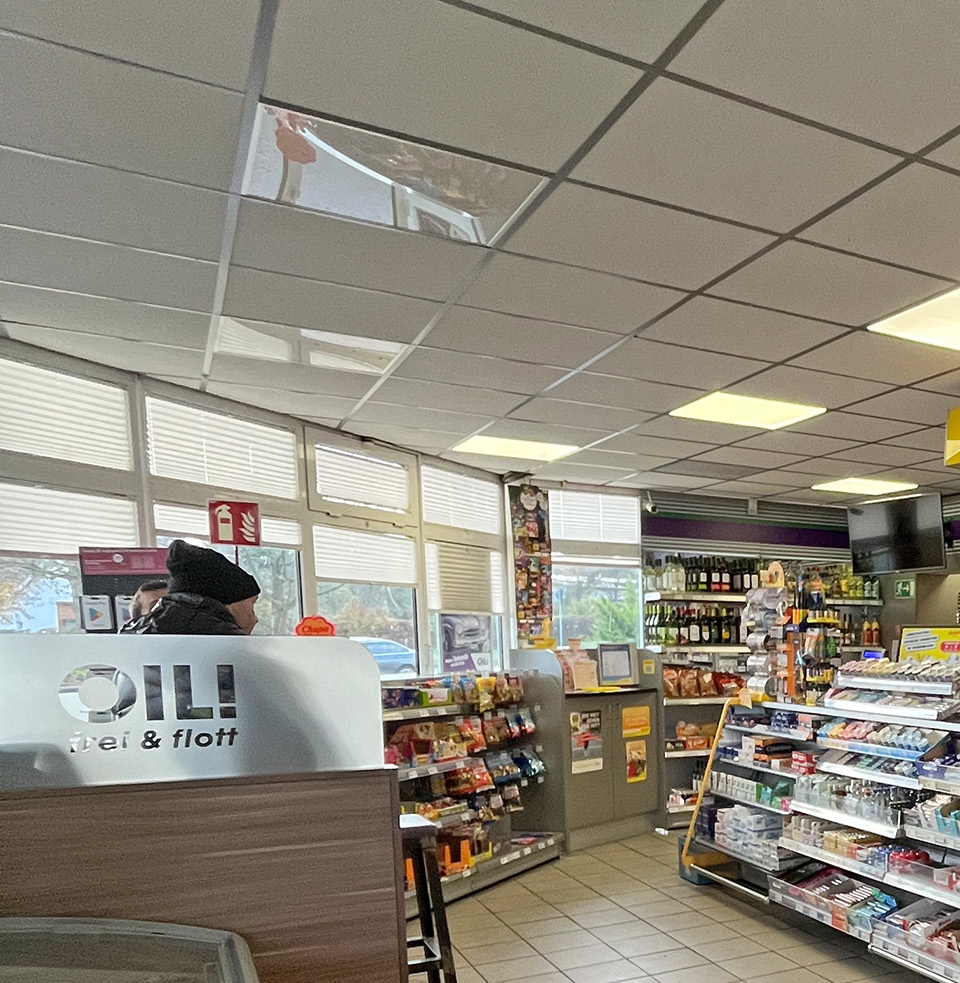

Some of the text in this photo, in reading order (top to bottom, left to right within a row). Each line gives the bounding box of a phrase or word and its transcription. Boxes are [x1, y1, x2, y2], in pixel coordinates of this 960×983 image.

[58, 664, 237, 723] OIL!
[141, 730, 162, 749] &
[172, 728, 238, 748] flott
